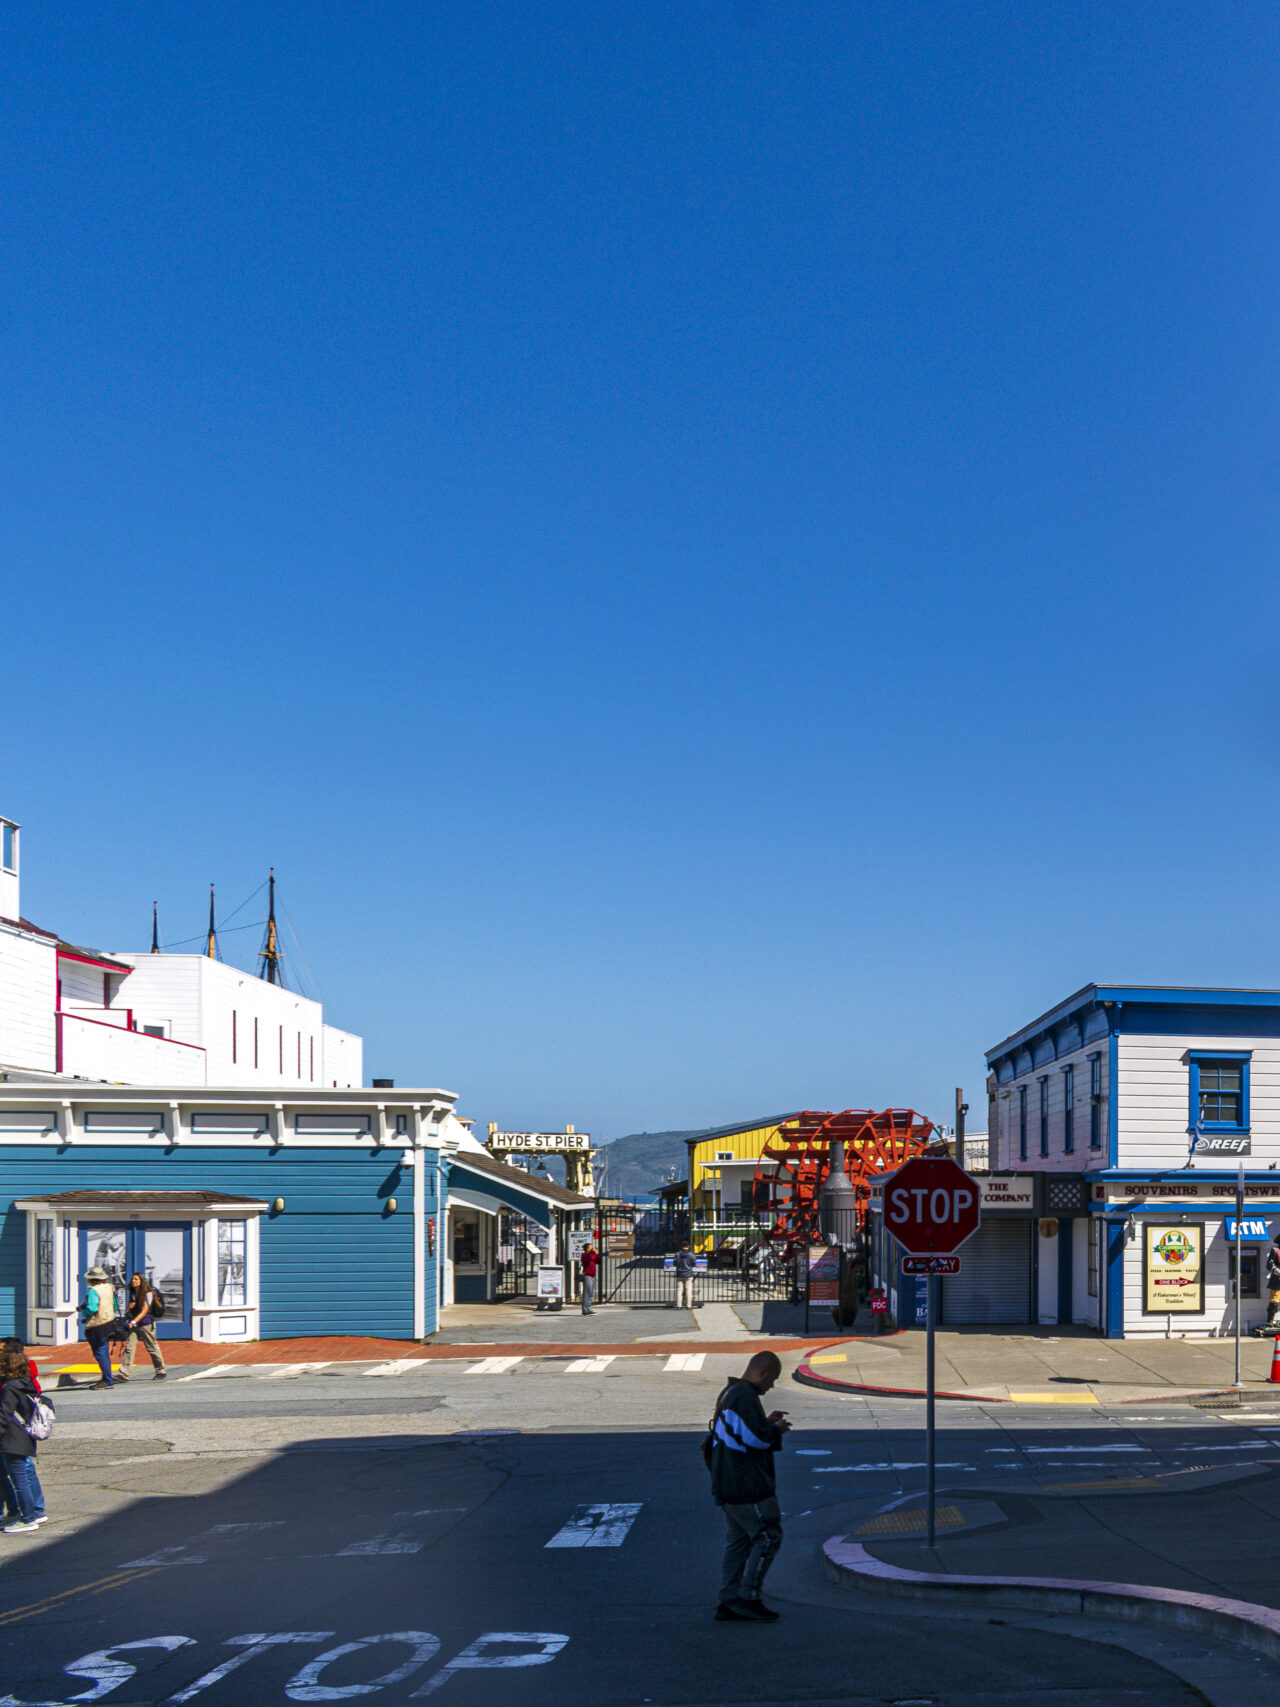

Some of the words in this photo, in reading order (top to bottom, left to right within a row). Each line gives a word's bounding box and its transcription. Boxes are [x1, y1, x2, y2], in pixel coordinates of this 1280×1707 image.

[497, 1135, 531, 1147] HYDE
[555, 1137, 584, 1148] PIER
[1209, 1139, 1250, 1153] REEF
[988, 1183, 1009, 1192] THE
[1125, 1185, 1198, 1196] SOUVENIRS
[984, 1194, 1031, 1203] COMPANY
[889, 1188, 973, 1224] STOP
[1230, 1221, 1265, 1234] ATM
[872, 1301, 887, 1309] FDC
[0, 1631, 571, 1707] STOP
